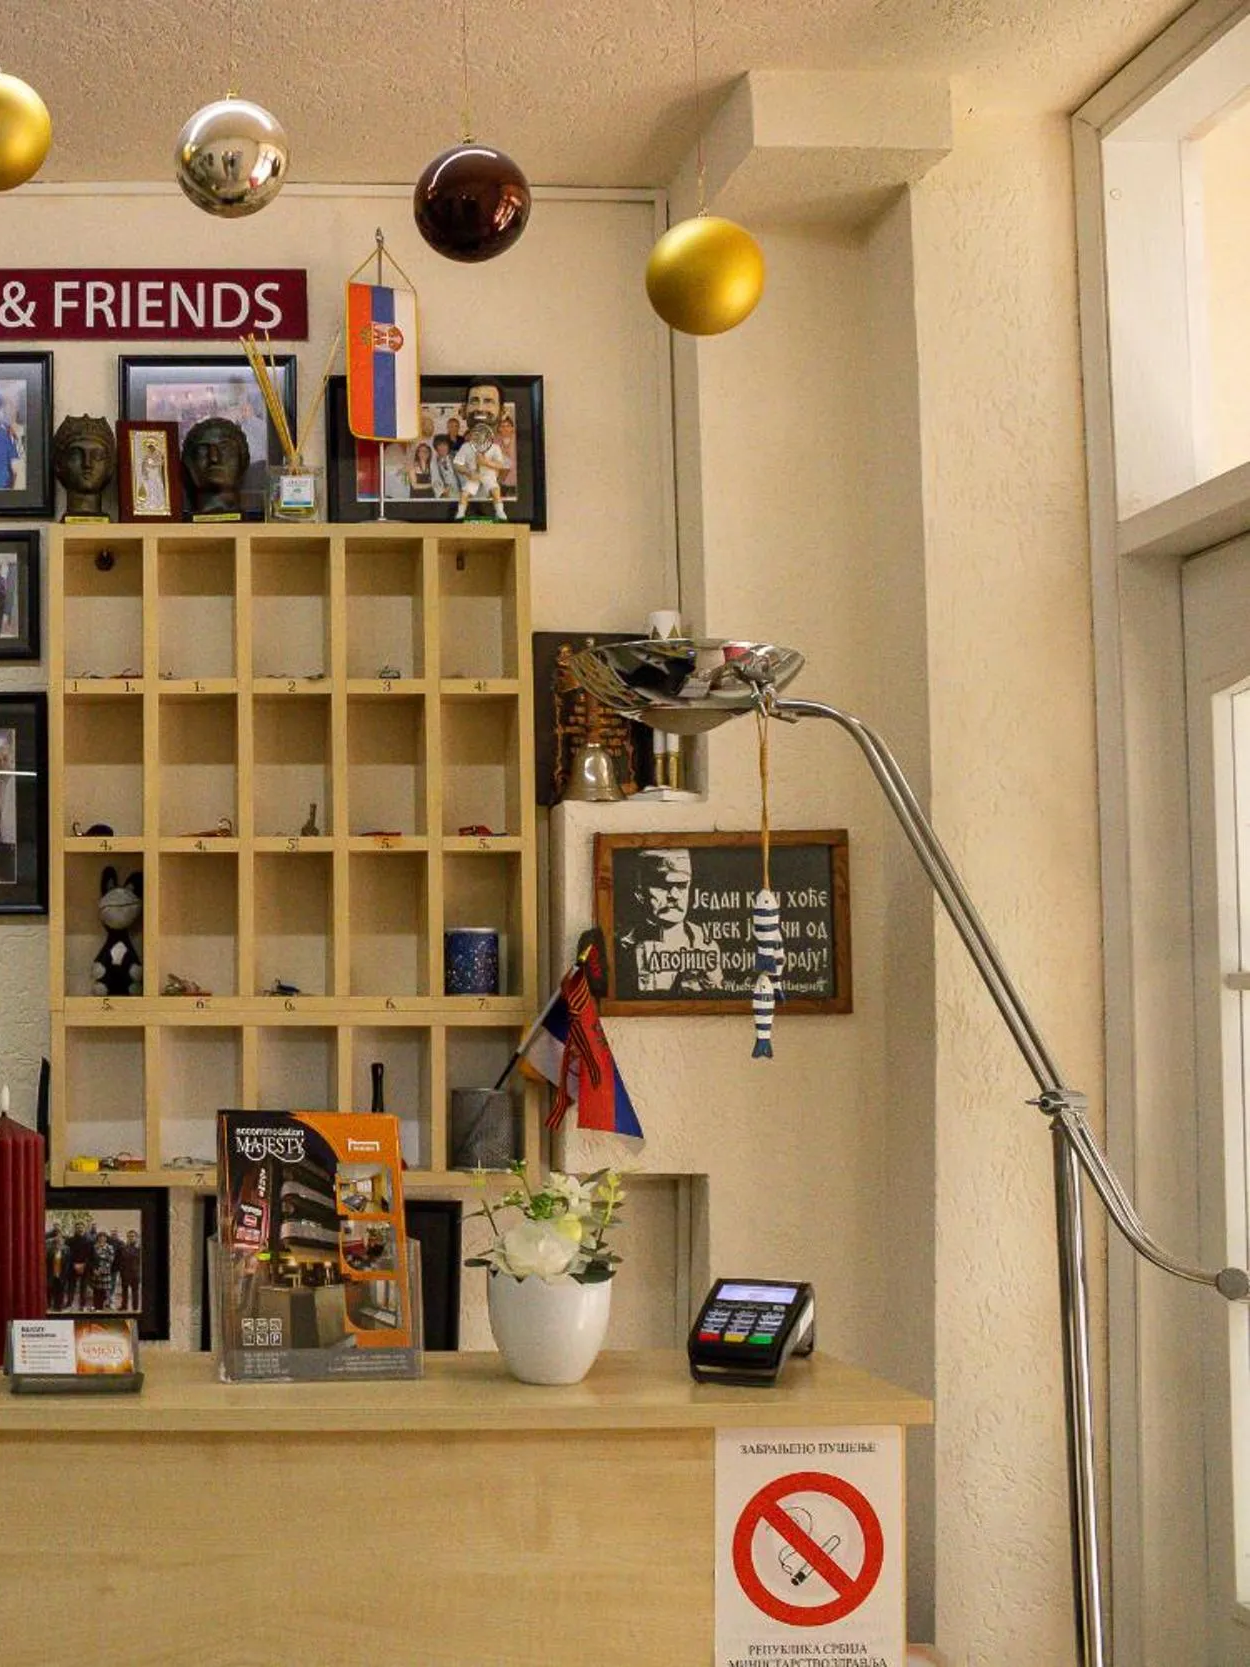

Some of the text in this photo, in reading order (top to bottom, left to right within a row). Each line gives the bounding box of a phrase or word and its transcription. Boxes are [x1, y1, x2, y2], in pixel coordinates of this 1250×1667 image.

[53, 281, 283, 330] FRIENDS
[236, 1136, 306, 1161] MAJESTY
[740, 1442, 876, 1455] ЗАБРАЊЕНО ПУШЕЊЕ
[748, 1643, 868, 1655] РЕПУБЛИКА СРБИЈА
